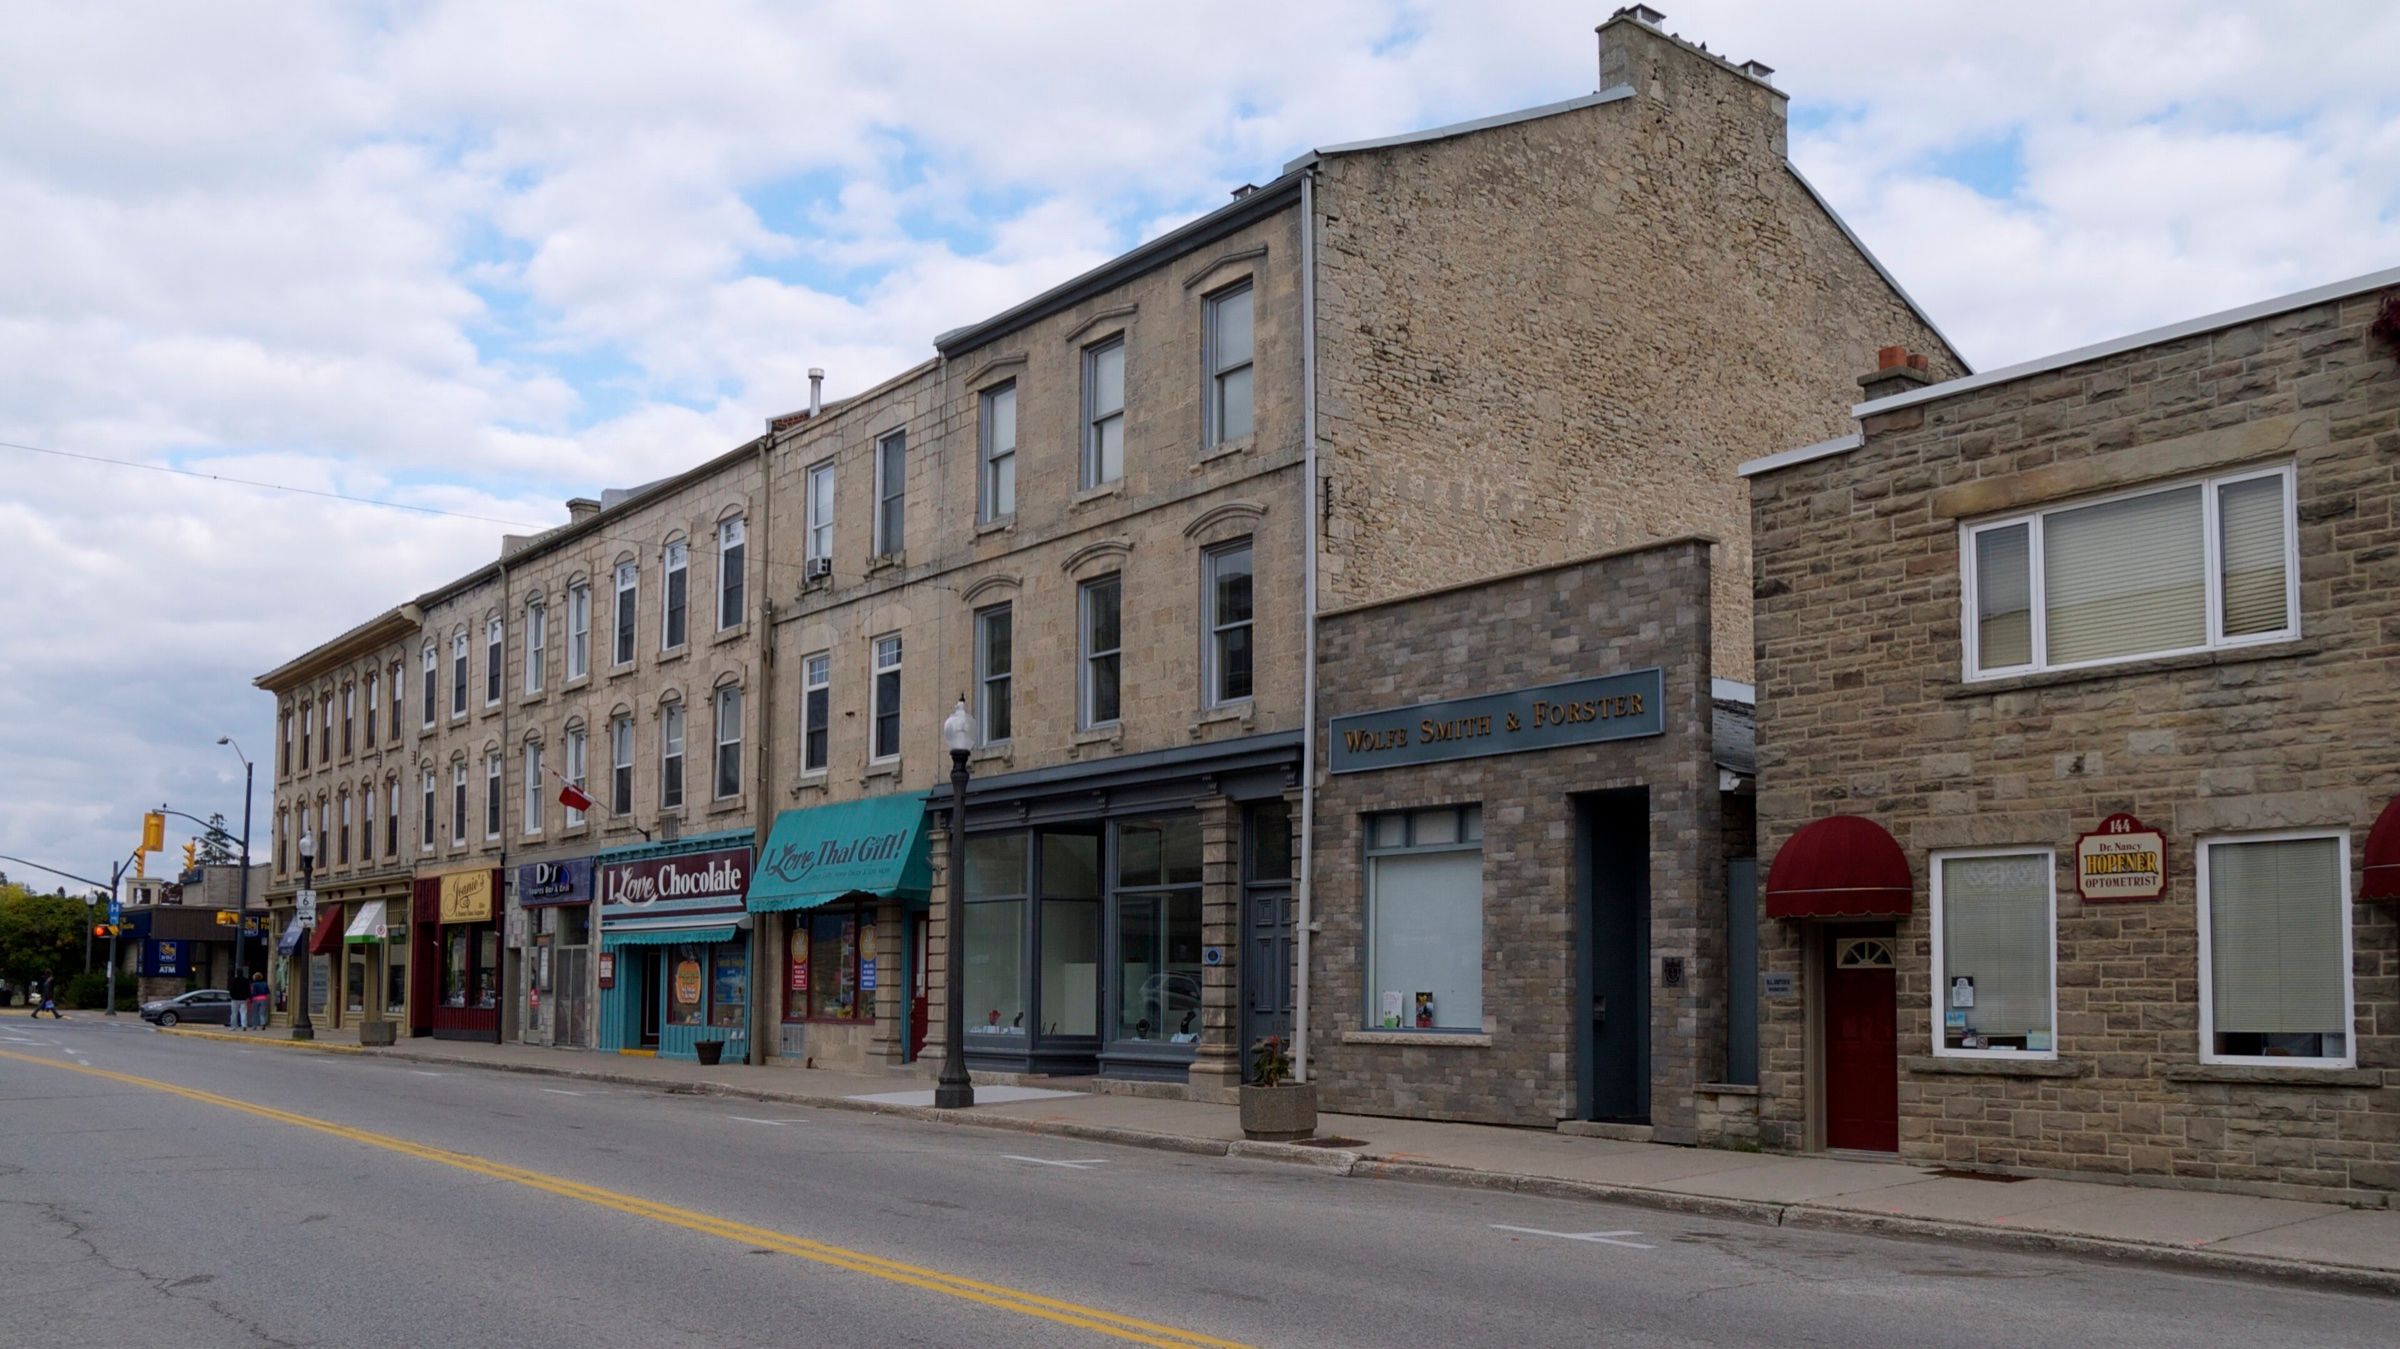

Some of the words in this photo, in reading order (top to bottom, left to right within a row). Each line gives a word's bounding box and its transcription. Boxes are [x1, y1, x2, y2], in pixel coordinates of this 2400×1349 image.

[1344, 728, 1408, 753] WOLFE
[1419, 715, 1492, 744] SMITH
[1506, 711, 1521, 732] &
[1532, 692, 1644, 728] FORSTER
[2110, 818, 2131, 833] 144
[858, 829, 908, 862] Gift!
[2099, 843, 2113, 852] Dr.
[2115, 842, 2142, 852] Nancy
[765, 848, 777, 872] I
[767, 842, 815, 883] Love
[608, 870, 616, 901] I
[613, 865, 659, 908] Love
[658, 858, 742, 896] Chocolate
[2085, 876, 2158, 888] OPTOMETRIST
[110, 904, 119, 913] H
[302, 896, 310, 906] 6
[159, 966, 176, 974] ATM
